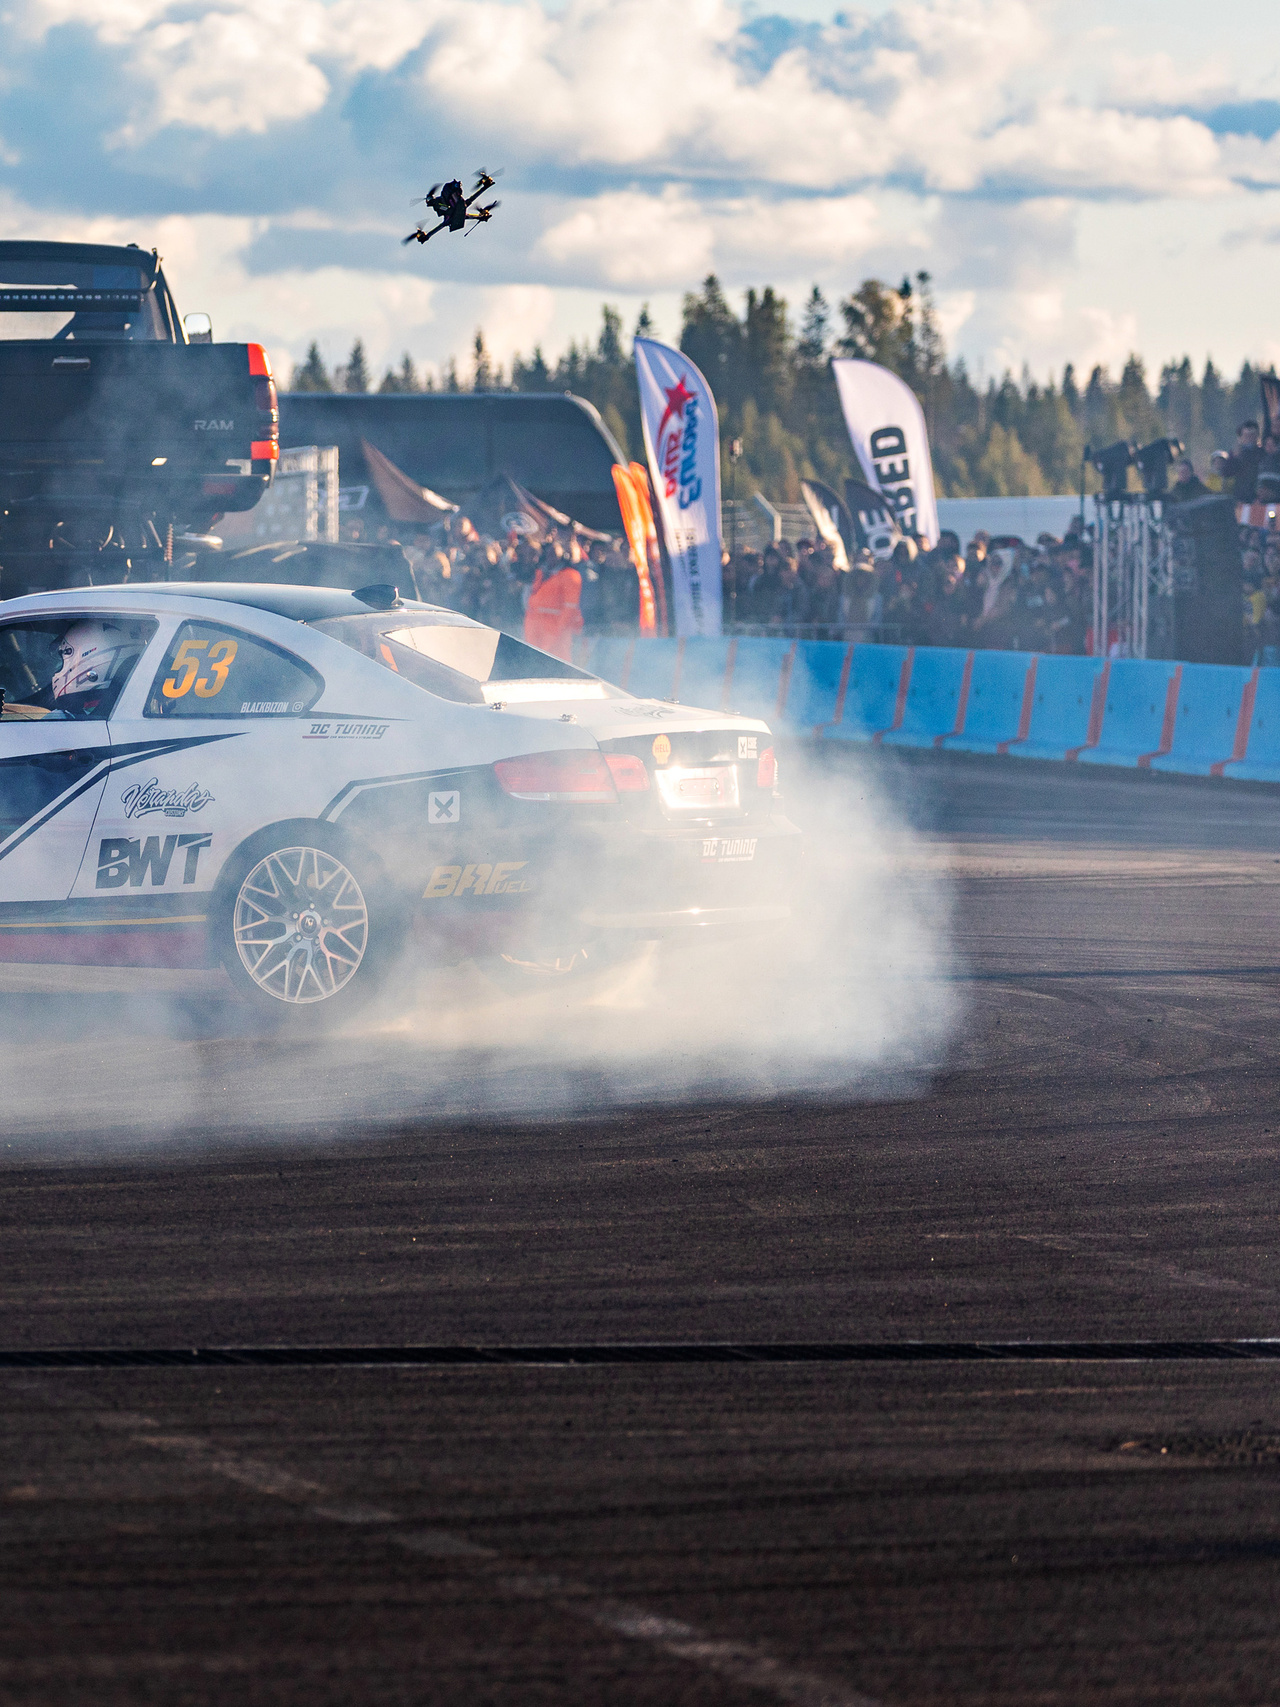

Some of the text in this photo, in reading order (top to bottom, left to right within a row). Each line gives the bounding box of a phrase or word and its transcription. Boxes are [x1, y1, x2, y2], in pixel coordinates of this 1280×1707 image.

[194, 419, 234, 430] RAM
[162, 640, 238, 698] 53
[240, 702, 289, 713] BLACKBIZON
[95, 832, 213, 889] BWT
